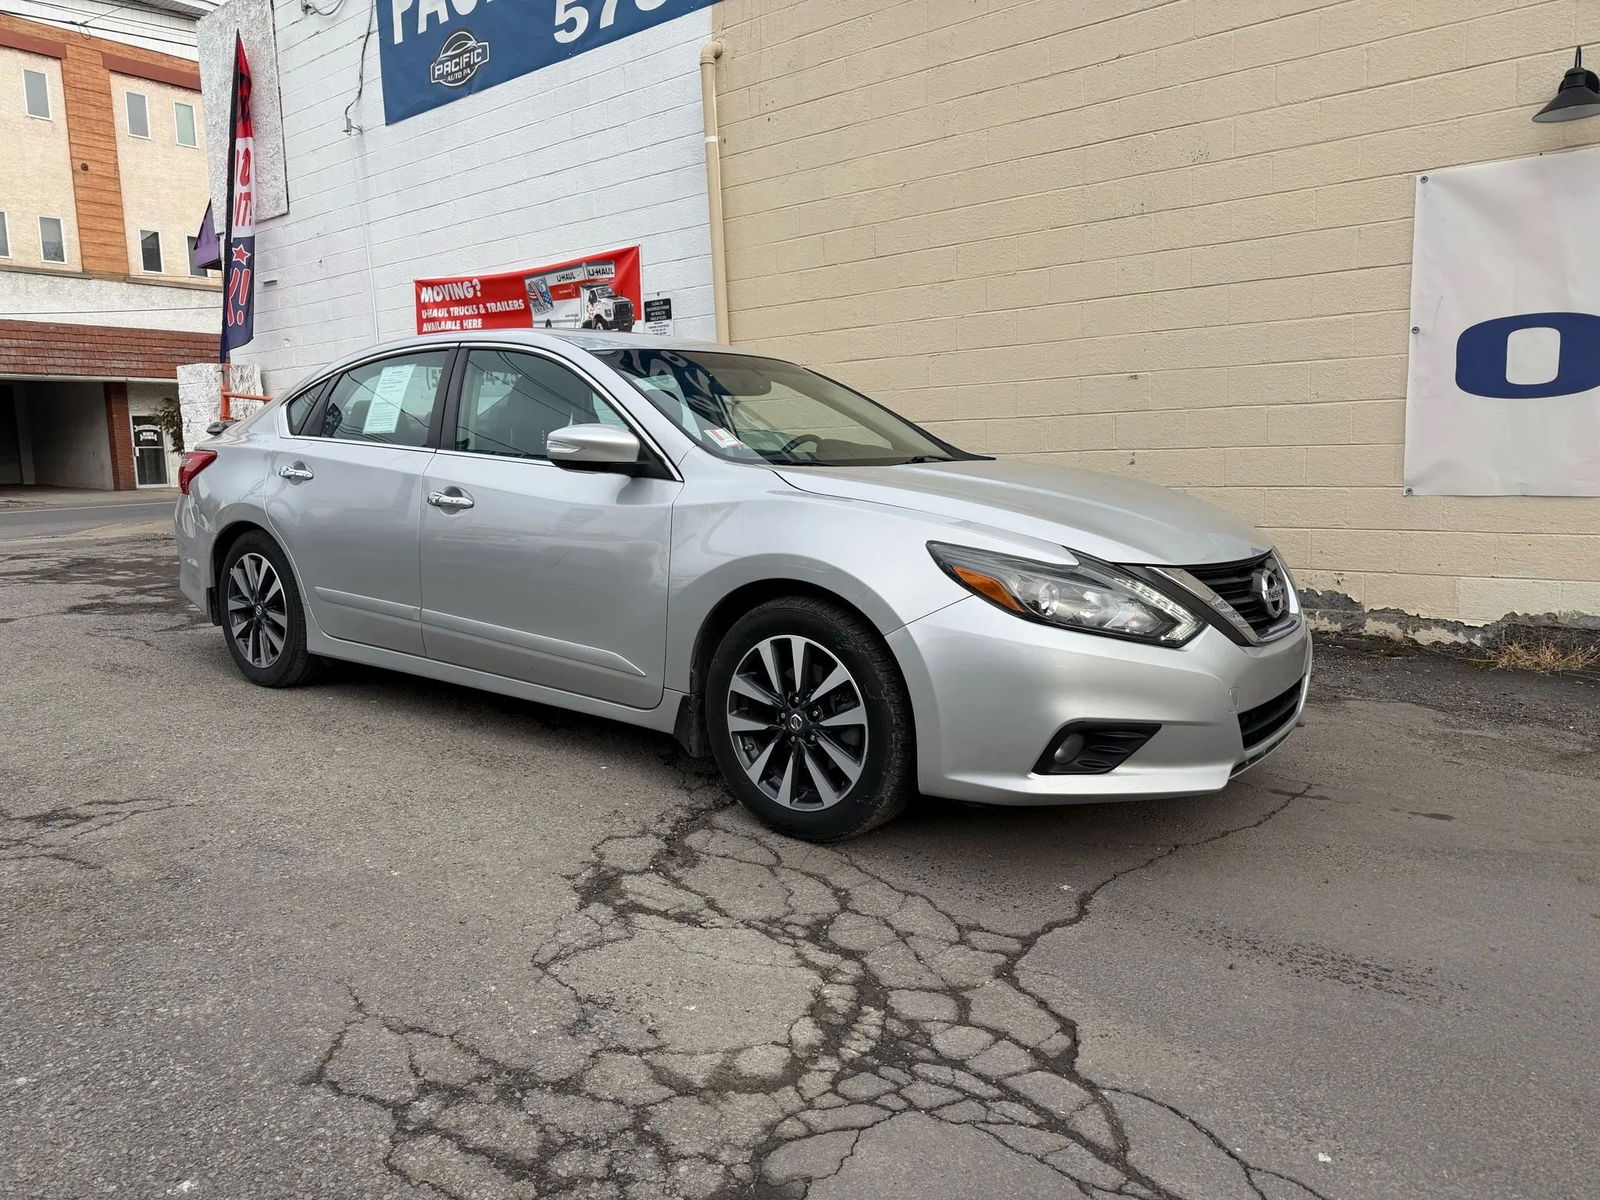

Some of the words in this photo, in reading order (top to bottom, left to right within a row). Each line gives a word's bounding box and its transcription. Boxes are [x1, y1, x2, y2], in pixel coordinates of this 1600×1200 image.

[553, 0, 667, 44] 57
[434, 48, 482, 79] PACIFIC
[447, 72, 462, 82] AUTO
[420, 278, 482, 303] MOVING?
[449, 304, 478, 317] TRUCKS
[479, 304, 486, 314] &
[486, 299, 525, 313] TRAILERS
[422, 321, 461, 333] AVAILABLE
[462, 318, 482, 329] HERE
